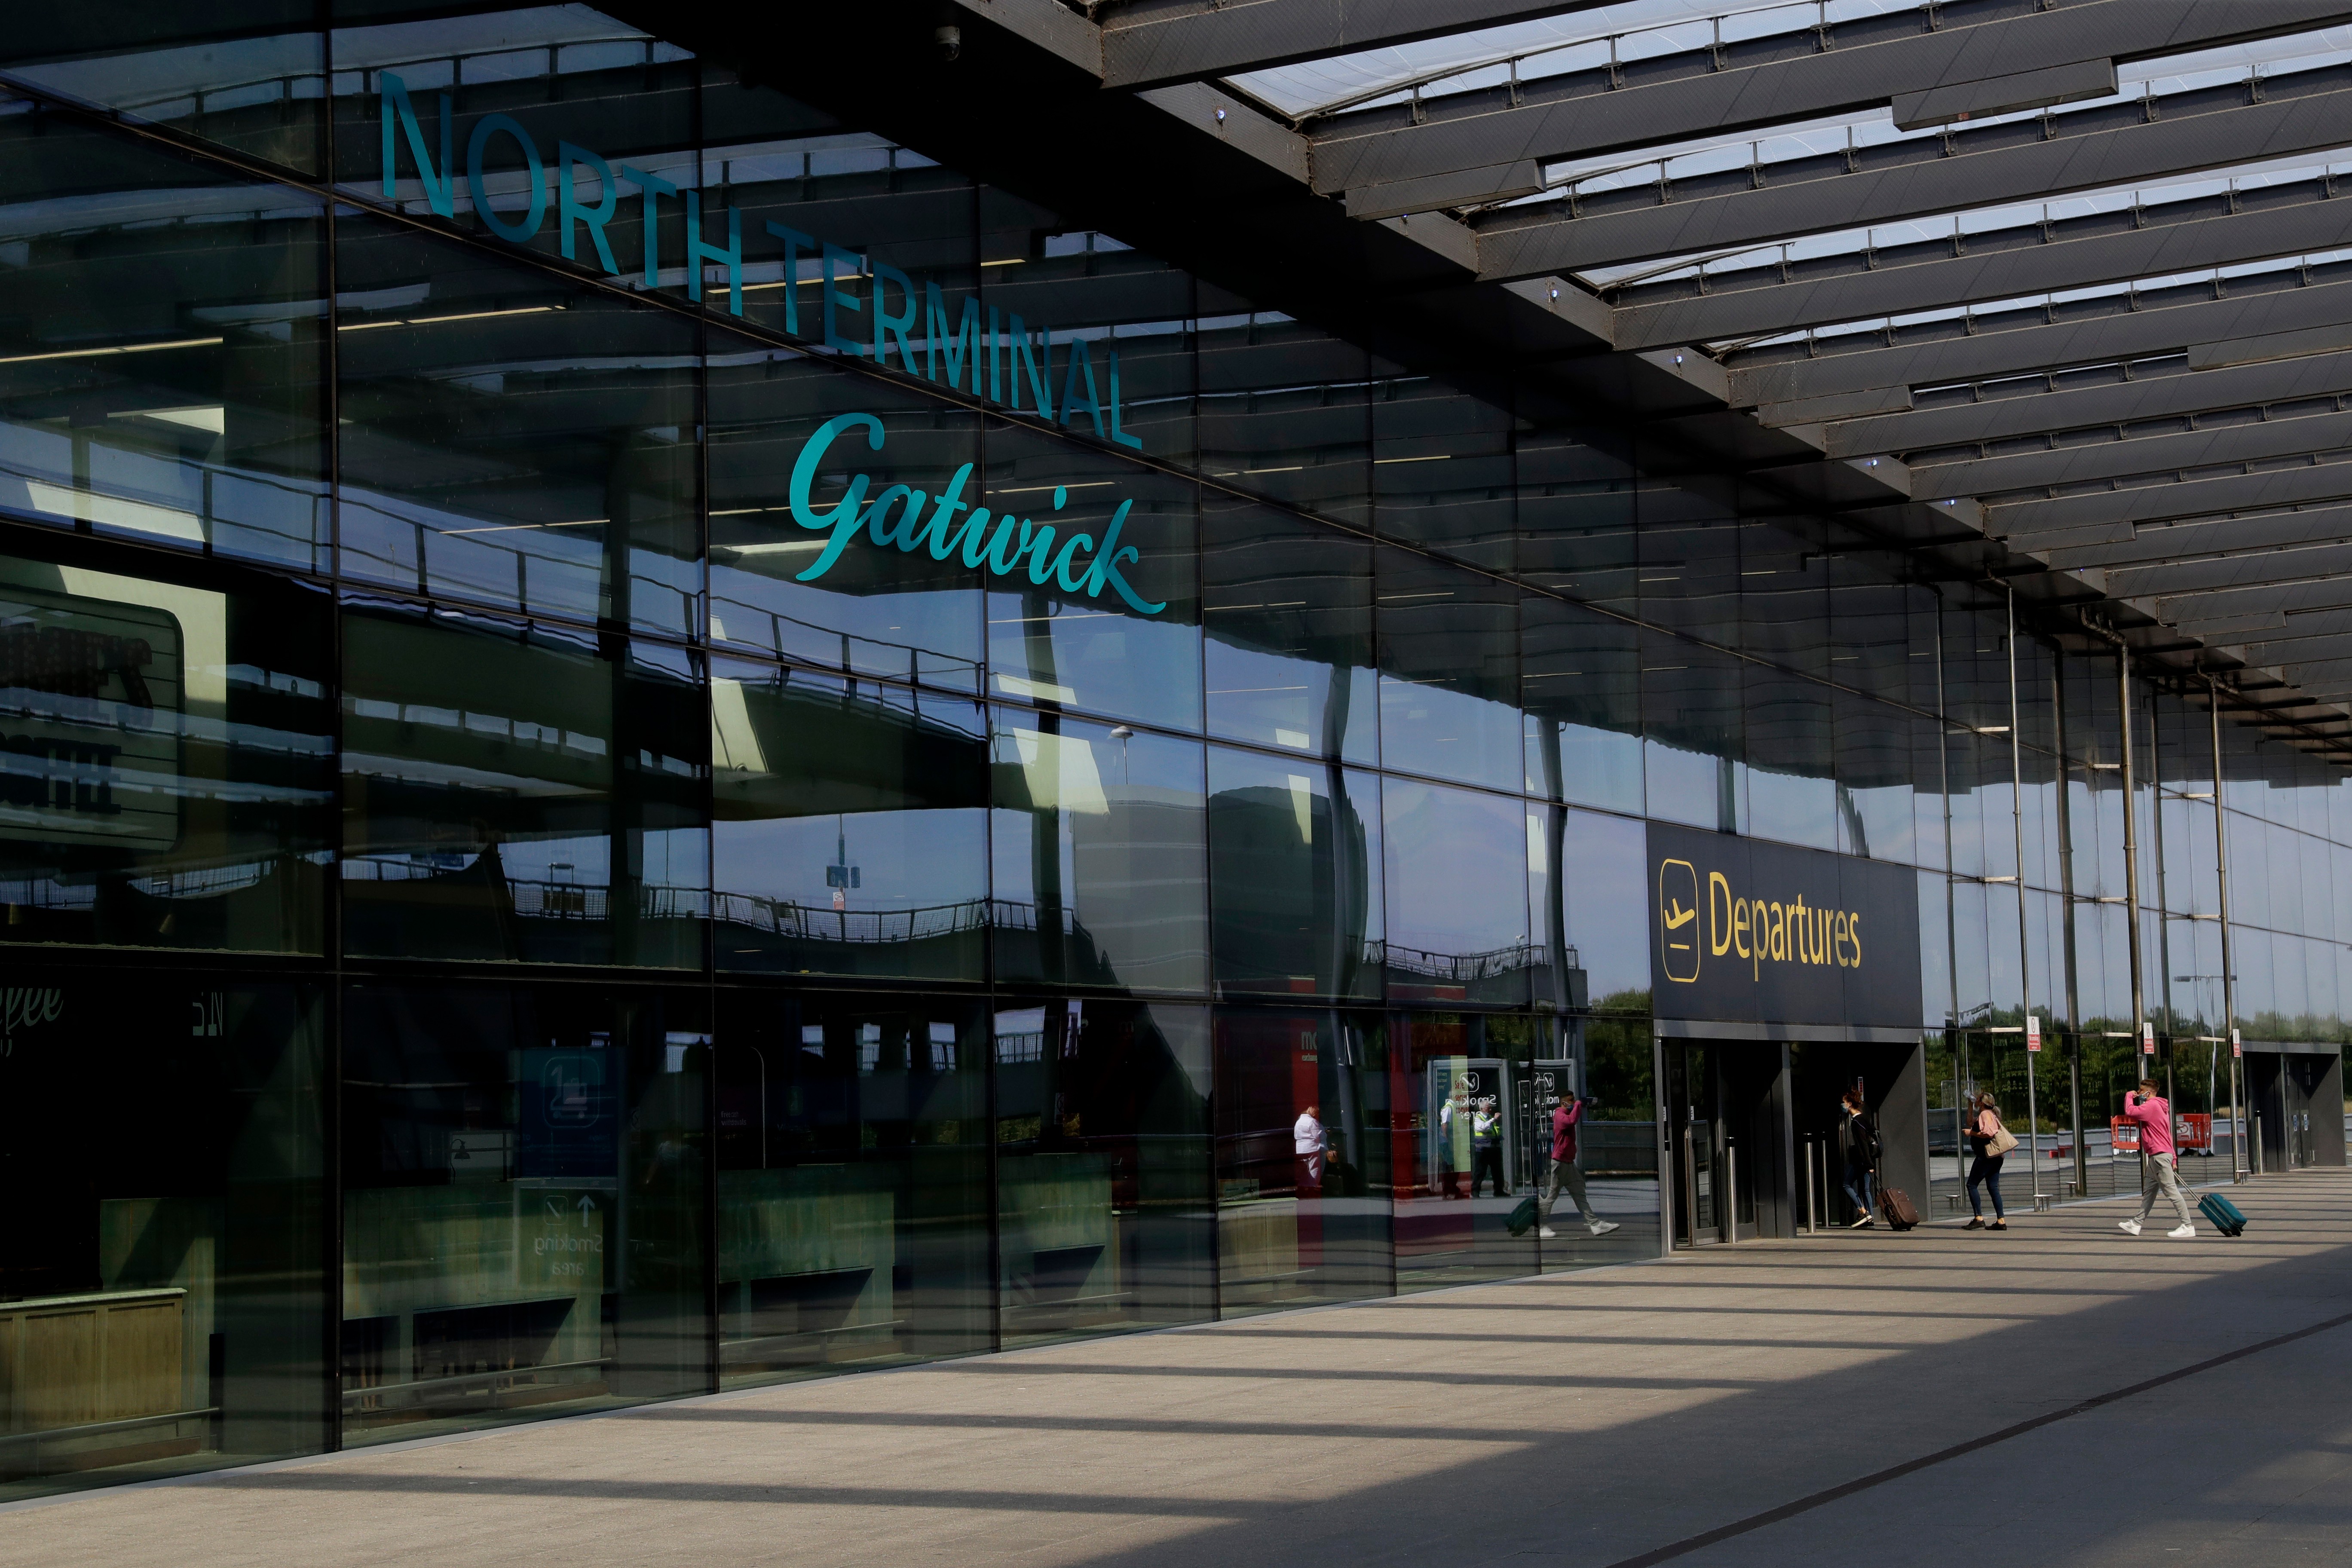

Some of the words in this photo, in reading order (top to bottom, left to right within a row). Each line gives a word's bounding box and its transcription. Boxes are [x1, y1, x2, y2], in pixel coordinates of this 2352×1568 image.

[380, 70, 743, 317] NORTH
[766, 219, 1143, 450] TERMINAL
[789, 412, 1166, 615] Gatwick
[1709, 872, 1861, 982] Departures
